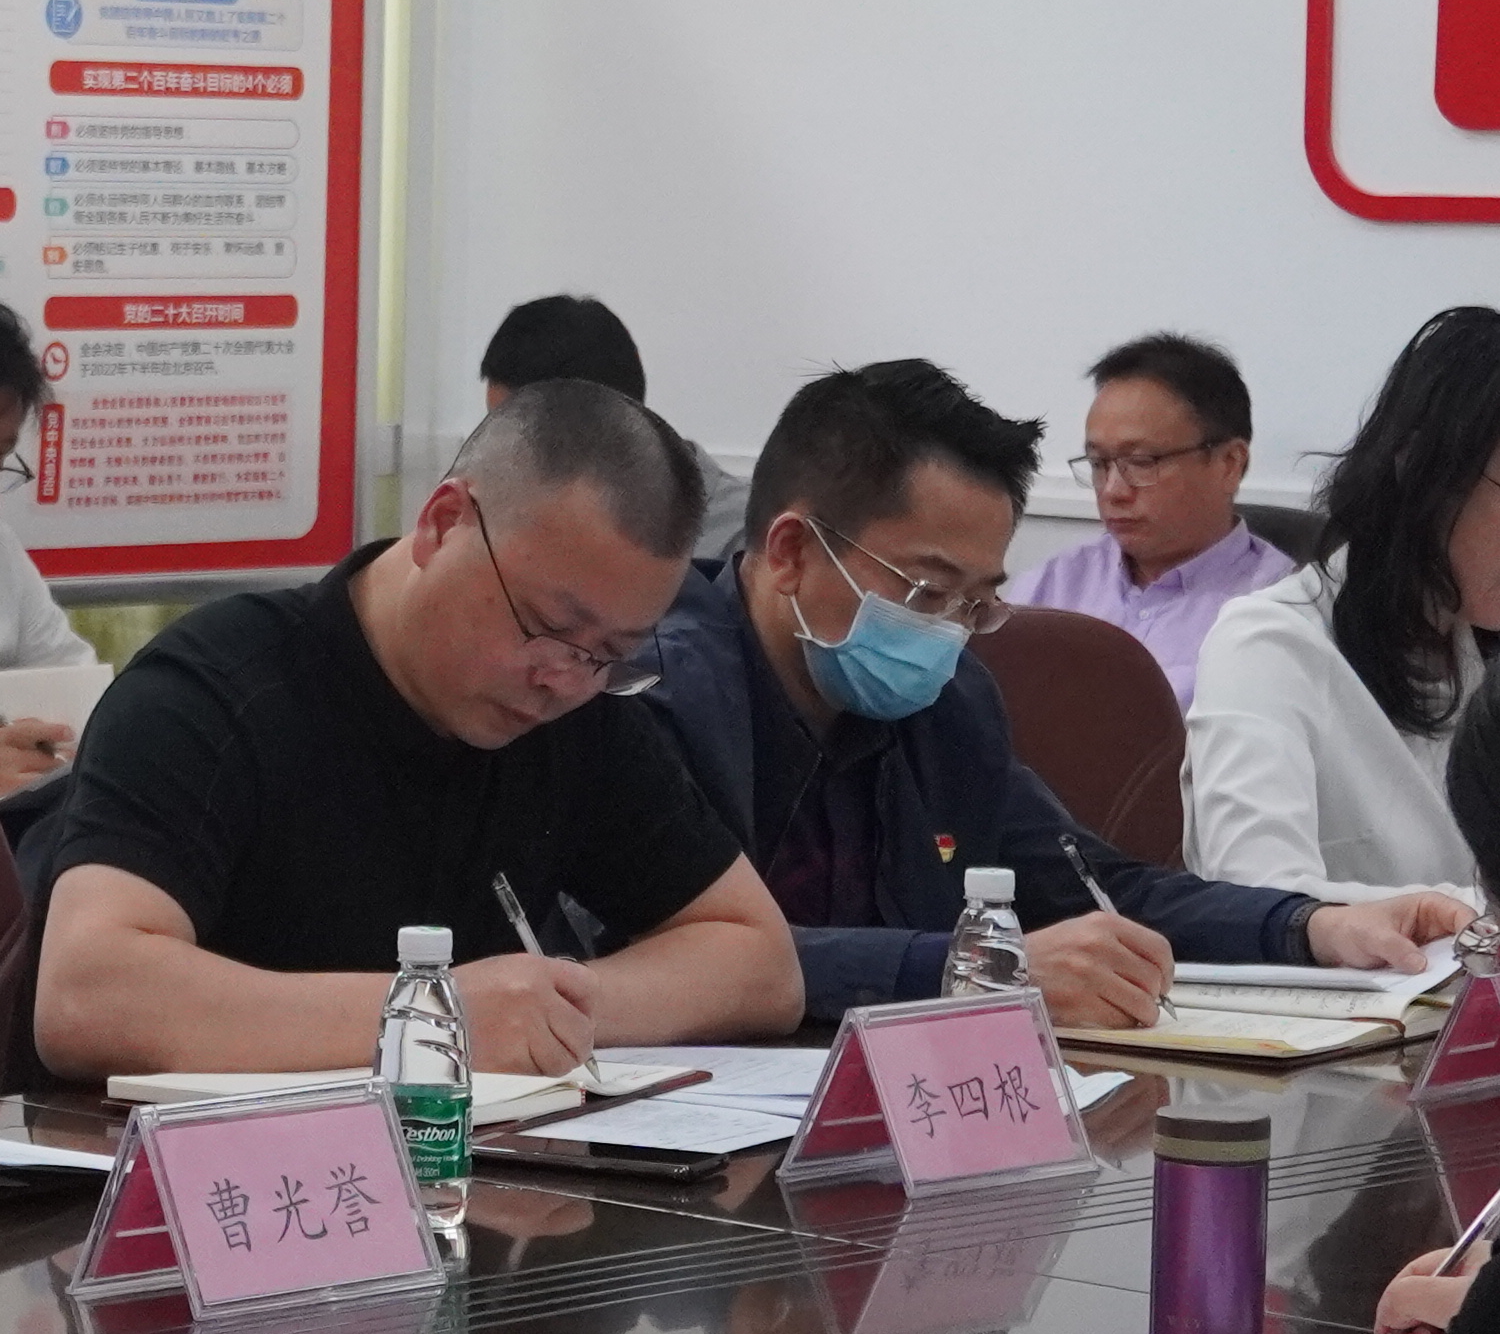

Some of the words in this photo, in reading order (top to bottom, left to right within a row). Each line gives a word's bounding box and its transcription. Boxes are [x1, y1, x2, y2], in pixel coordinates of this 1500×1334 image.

[83, 68, 293, 94] 实现第二个百年奋斗目标的4个必须
[123, 302, 245, 325] 党的二十大召开时间
[906, 1063, 1041, 1139] 李四根
[206, 1162, 382, 1253] 曹光誉
